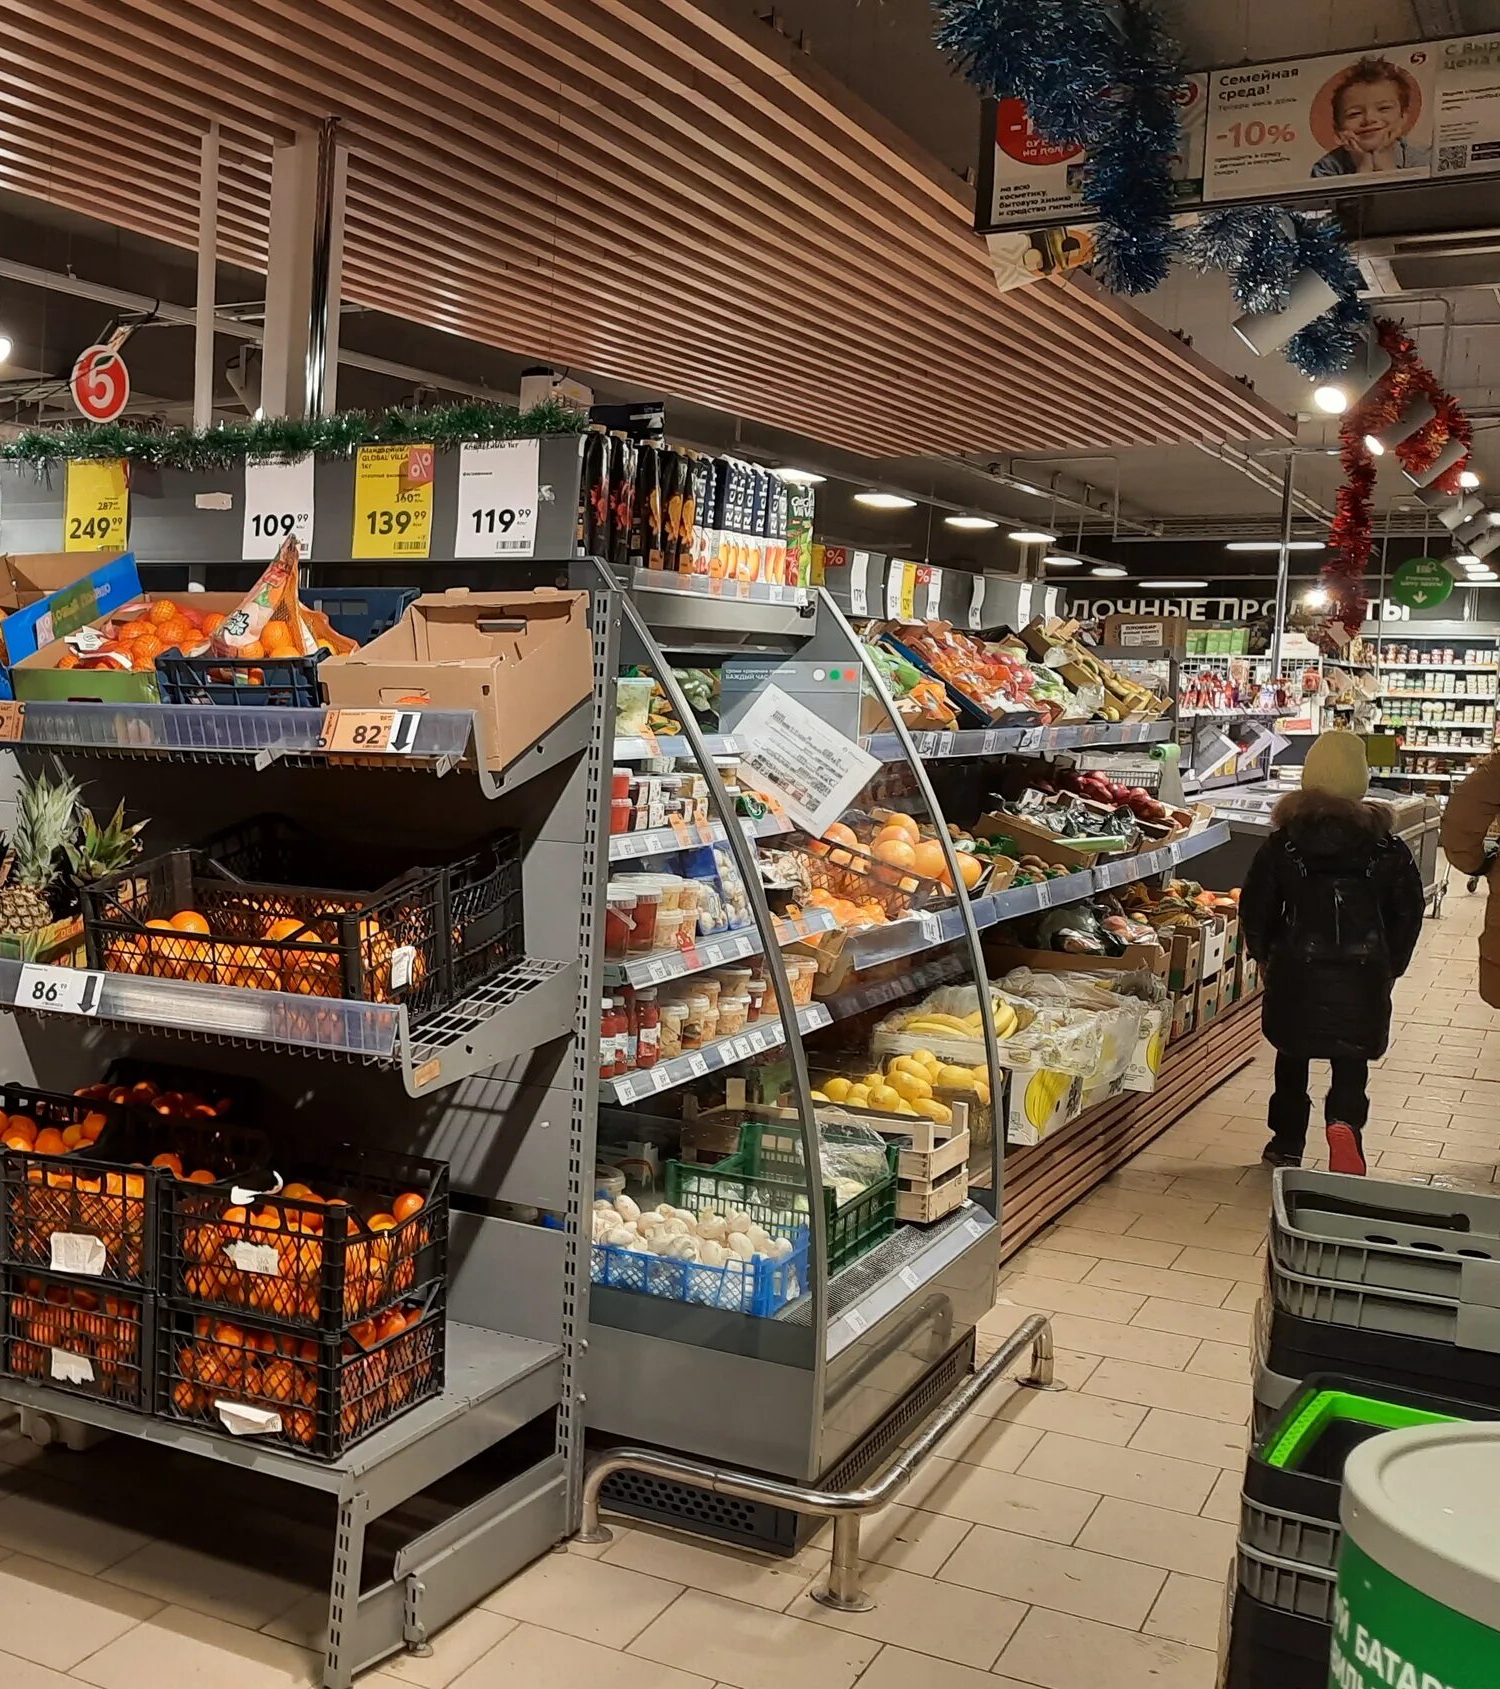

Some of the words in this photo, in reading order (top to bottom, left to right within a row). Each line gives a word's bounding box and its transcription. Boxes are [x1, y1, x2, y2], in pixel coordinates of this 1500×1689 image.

[1219, 68, 1299, 87] Семейная
[1218, 84, 1271, 102] среда!
[1216, 120, 1296, 149] -10%
[362, 454, 389, 462] GLOBAL
[69, 516, 111, 540] 249
[112, 517, 123, 527] 99
[251, 513, 296, 537] 109
[297, 513, 309, 523] 99
[367, 510, 412, 535] 139
[413, 511, 427, 520] 99
[472, 508, 516, 534] 119
[518, 508, 532, 518] 99
[1064, 598, 1207, 622] ЛОЧНЫЕ
[1218, 598, 1411, 622] ПРОТЫ
[352, 725, 382, 744] 82
[32, 981, 58, 1002] 86
[1355, 1622, 1459, 1689] БАТА
